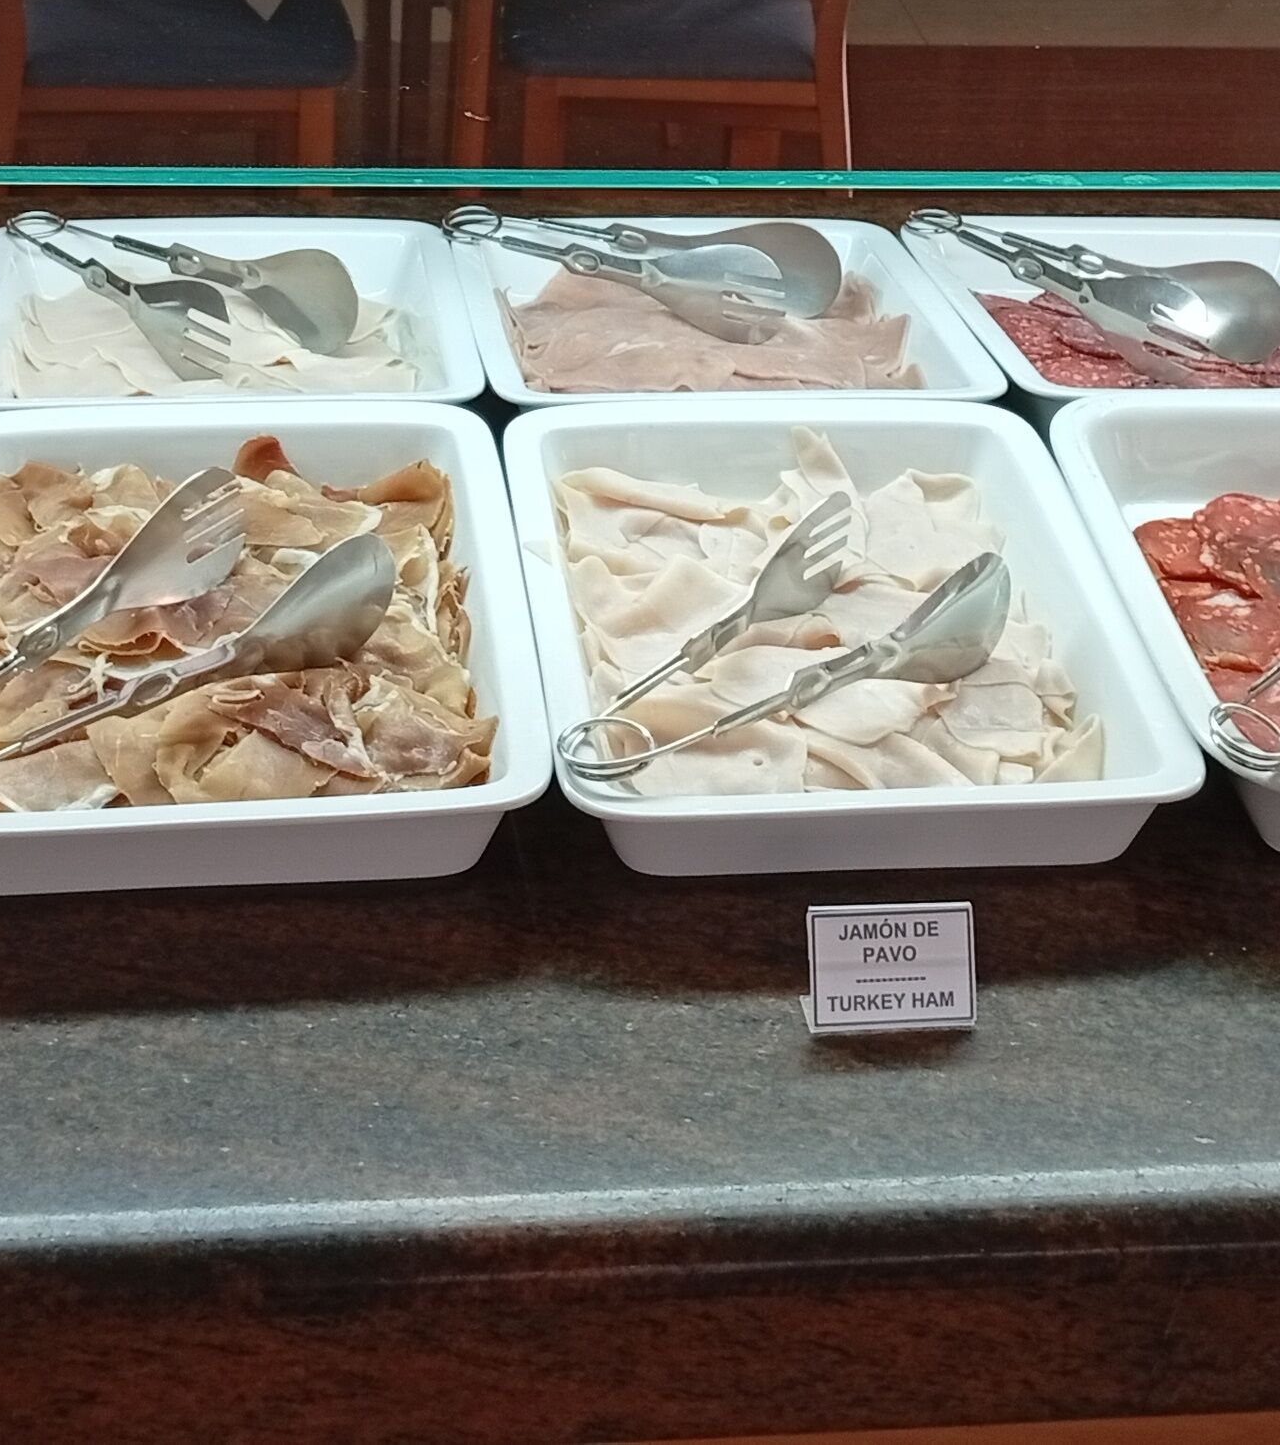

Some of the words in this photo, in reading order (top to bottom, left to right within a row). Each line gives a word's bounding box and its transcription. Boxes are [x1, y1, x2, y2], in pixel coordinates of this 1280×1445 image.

[839, 918, 907, 941] JAMÓN
[913, 921, 939, 938] DE
[863, 945, 917, 964] PAVO
[827, 993, 906, 1012] TURKEY
[912, 991, 955, 1009] HAM
